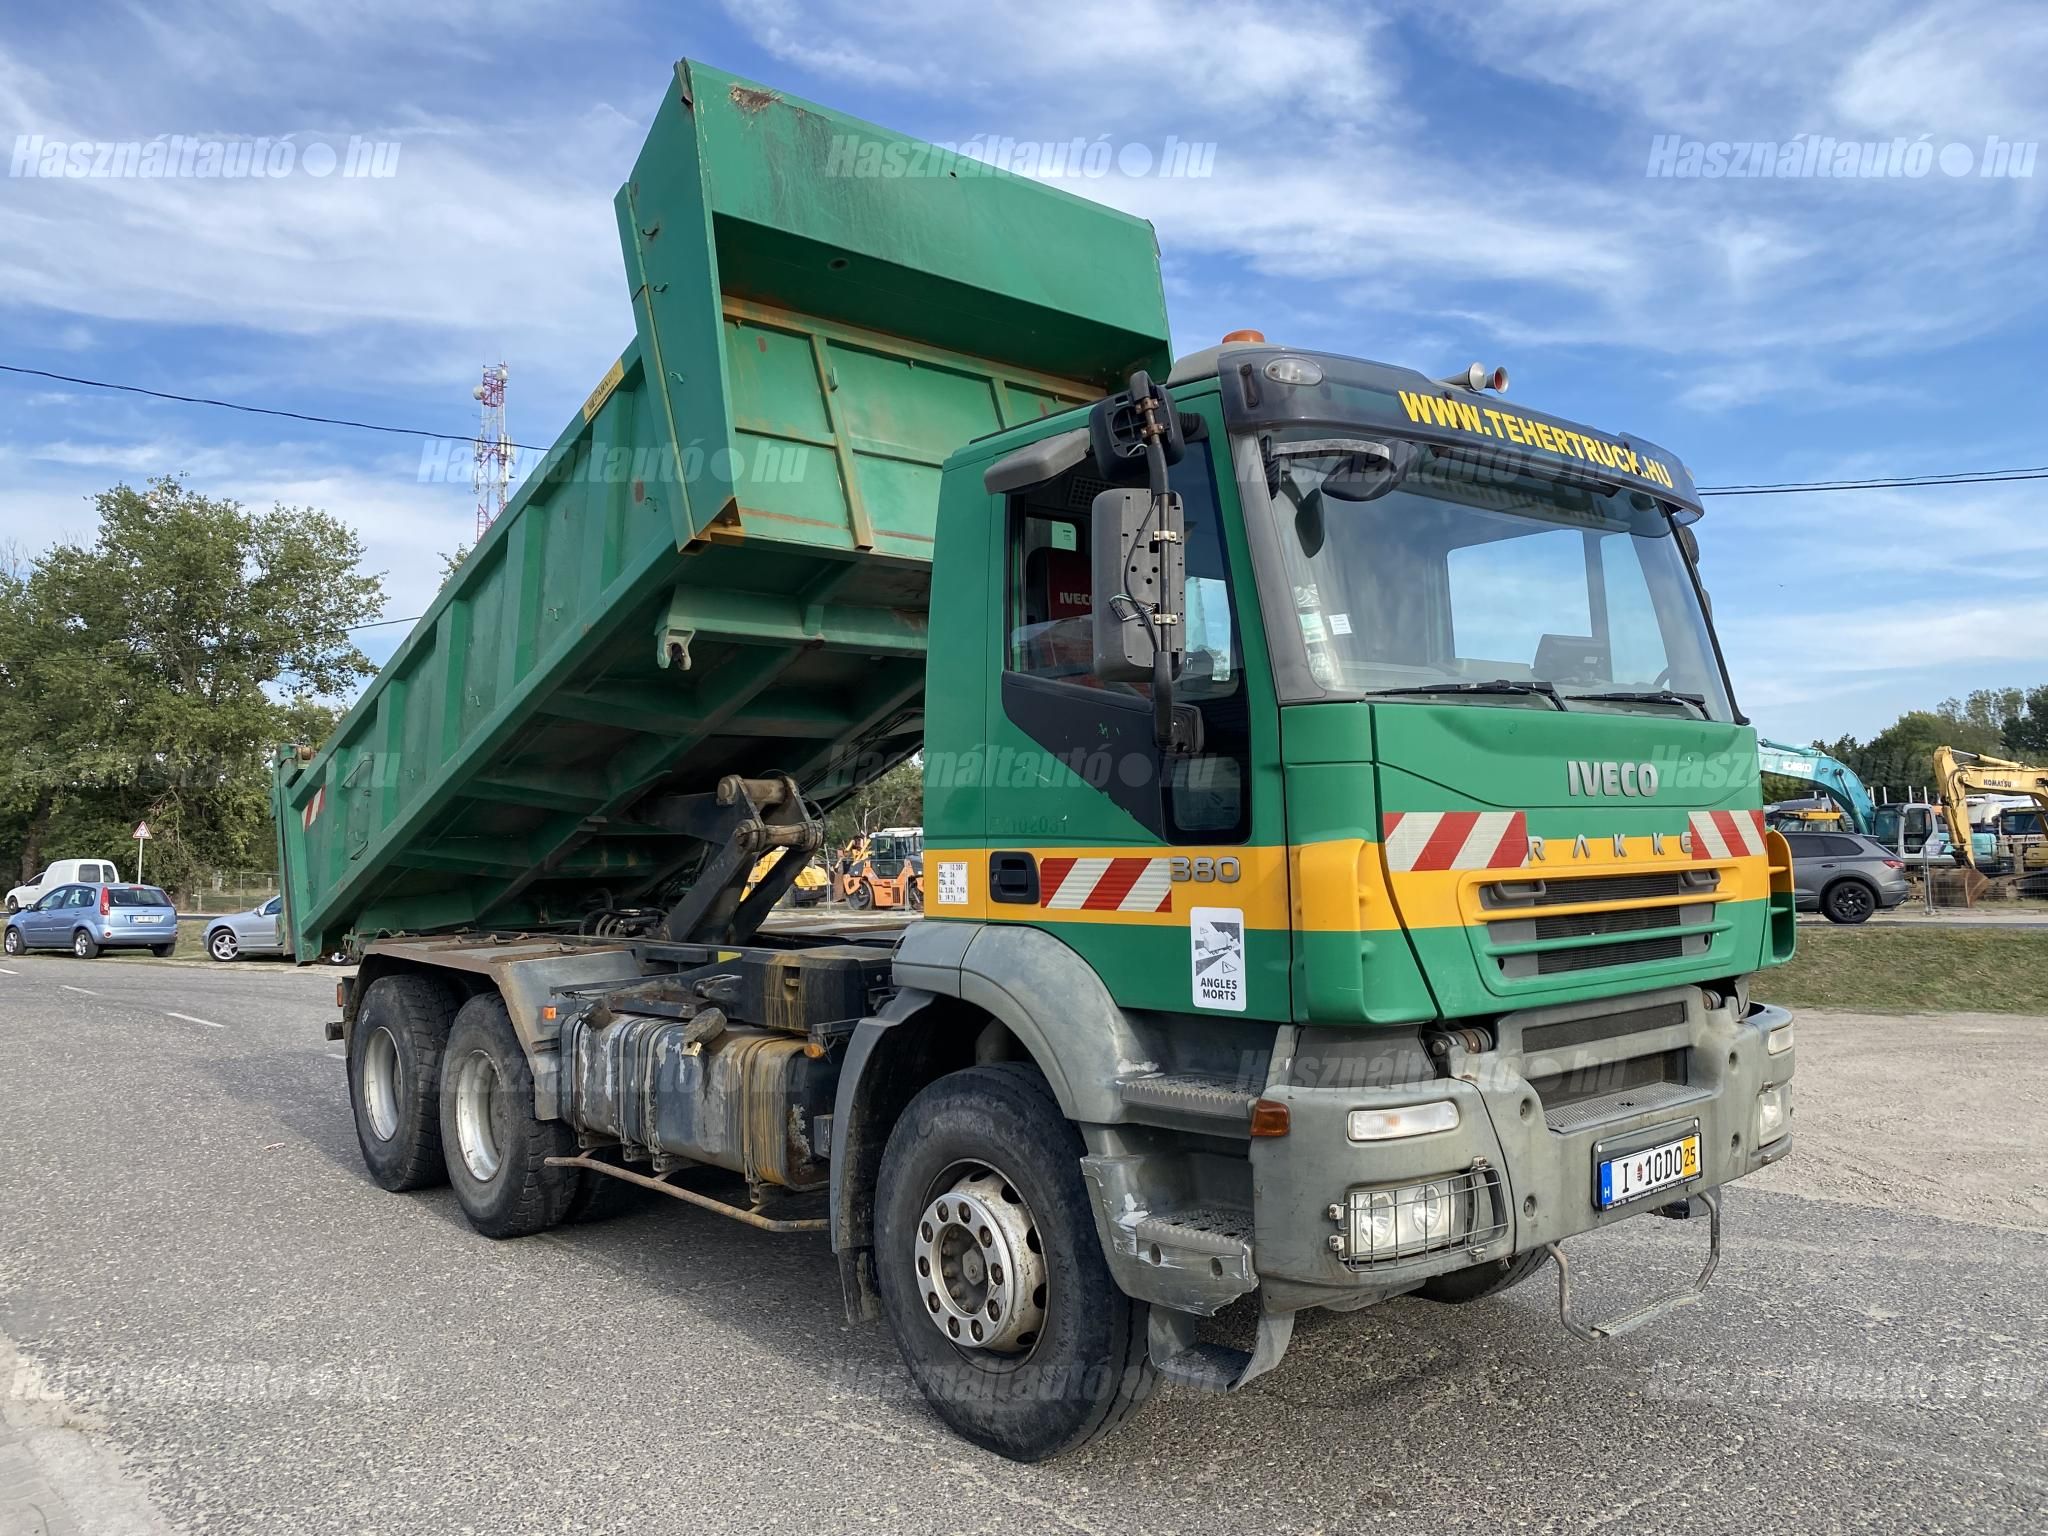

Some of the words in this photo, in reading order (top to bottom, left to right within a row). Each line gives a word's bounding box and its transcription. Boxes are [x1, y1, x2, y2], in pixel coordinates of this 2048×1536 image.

[1398, 390, 1673, 489] WWW.TEHERTRUCK.HU
[1060, 591, 1092, 606] IVEC
[1567, 760, 1659, 797] IVECO
[1983, 778, 2012, 788] KOMATSU
[1170, 855, 1241, 883] 380
[1200, 977, 1238, 989] ANGLES
[1202, 988, 1236, 1001] MORTS
[1684, 1146, 1696, 1168] 25
[1604, 1186, 1611, 1199] H
